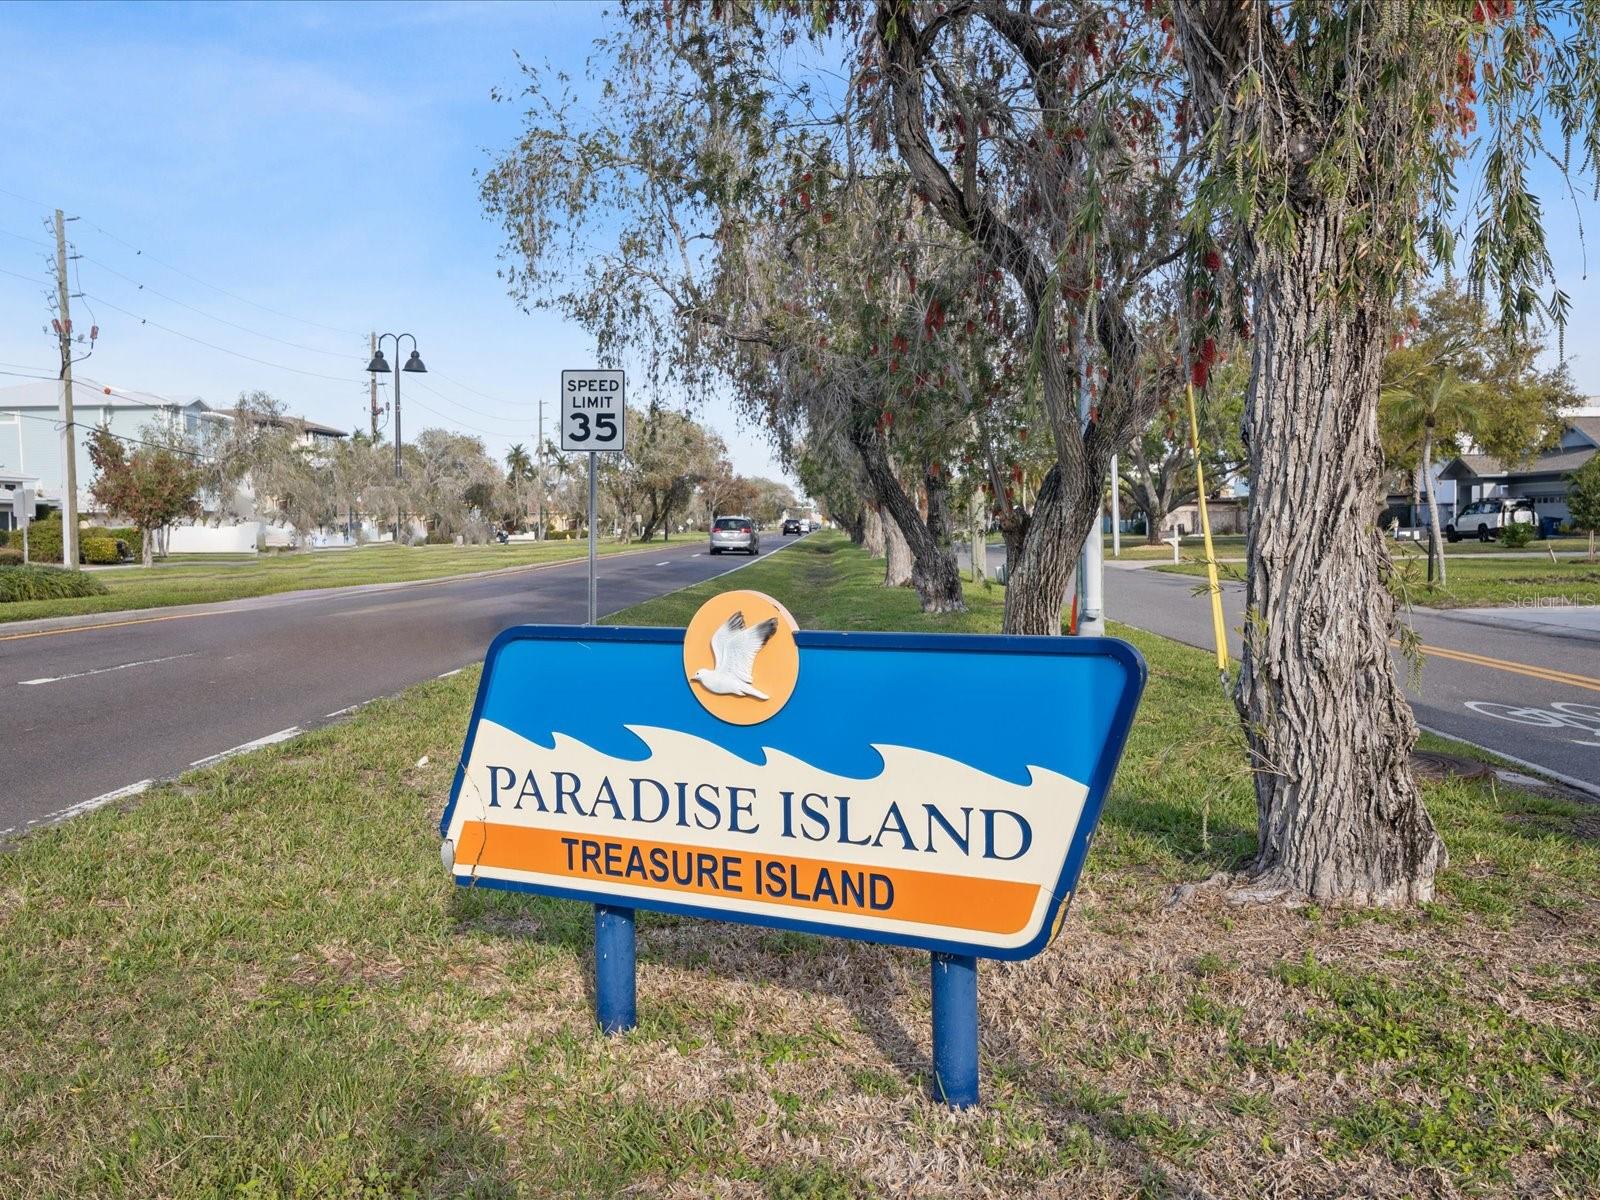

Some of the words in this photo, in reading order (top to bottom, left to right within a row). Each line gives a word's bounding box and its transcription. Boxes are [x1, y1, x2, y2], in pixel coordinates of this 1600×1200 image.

[567, 380, 619, 391] SPEED
[572, 396, 613, 408] LIMIT
[568, 412, 618, 442] 35
[486, 765, 760, 834] PARADISE
[779, 791, 1033, 861] ISLAND
[561, 837, 743, 893] TREASURE
[755, 859, 895, 911] ISLAND
